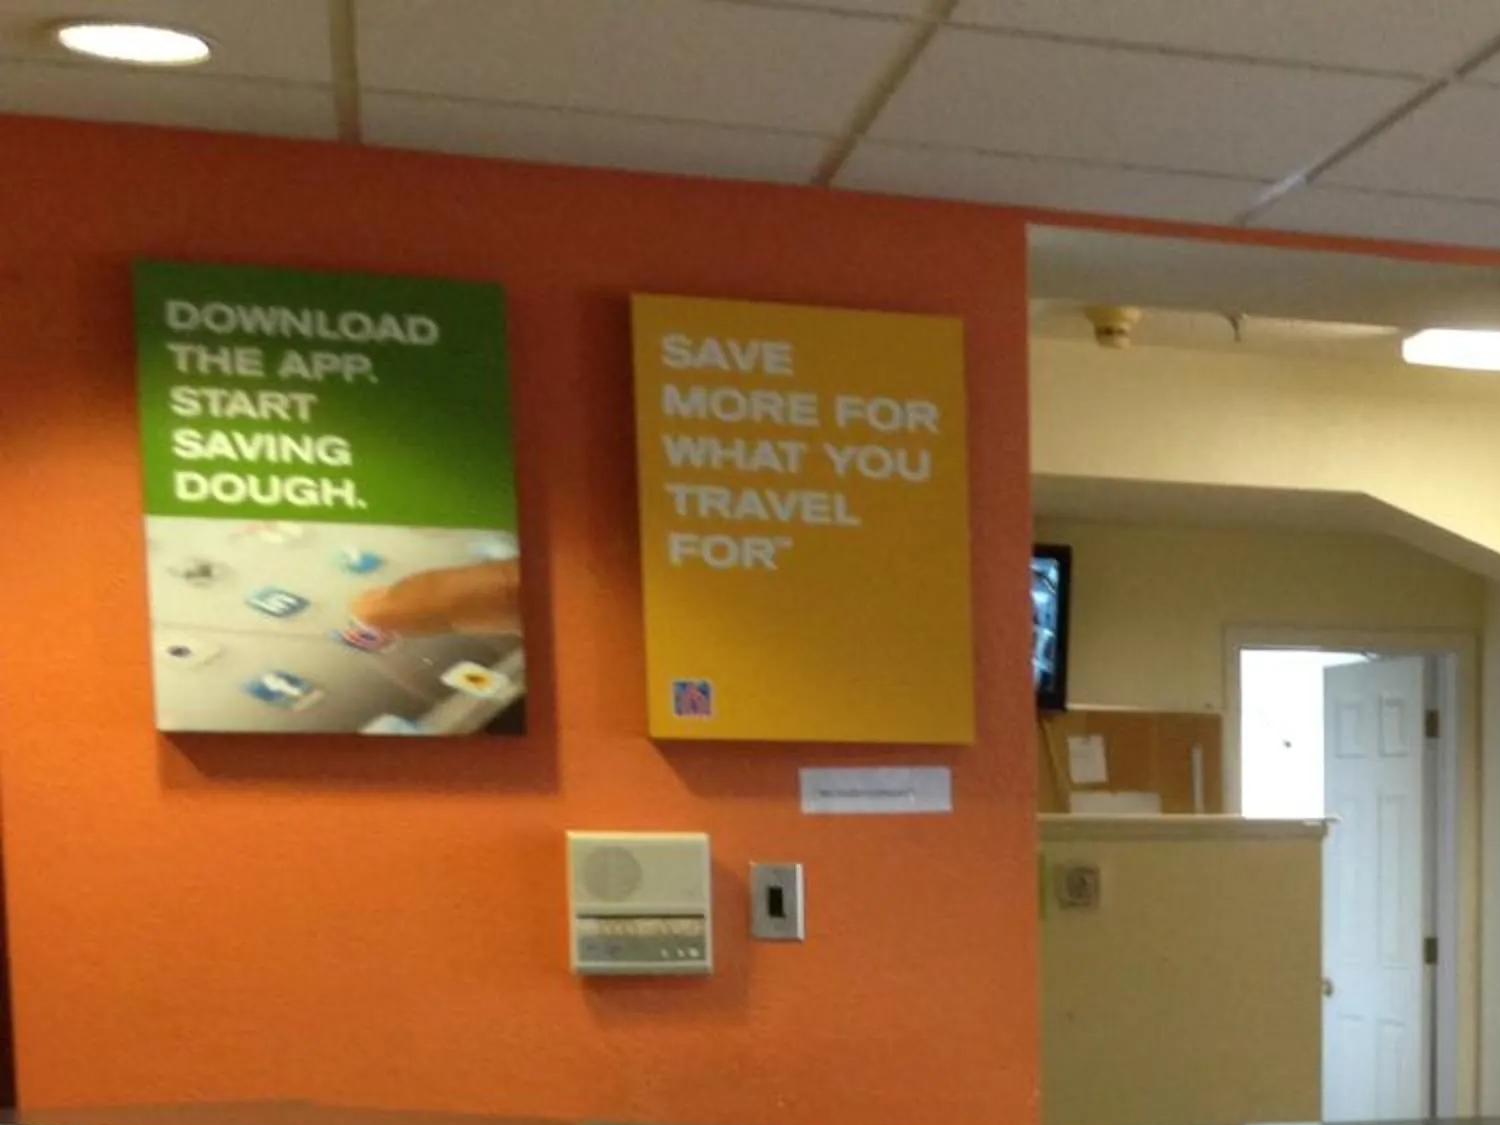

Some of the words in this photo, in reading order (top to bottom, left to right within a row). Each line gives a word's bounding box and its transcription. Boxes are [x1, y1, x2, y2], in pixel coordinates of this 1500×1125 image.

[165, 300, 440, 345] DOWNLOAD
[166, 342, 265, 377] THE
[278, 349, 379, 384] APP.
[661, 334, 794, 375] SAVE
[170, 386, 317, 423] START
[661, 384, 820, 427] MORE
[835, 393, 940, 434] FOR
[171, 429, 352, 467] SAVING
[662, 434, 807, 474] WHAT
[825, 442, 932, 482] YOU
[175, 470, 368, 510] DOUGH.
[664, 482, 861, 527] TRAVEL
